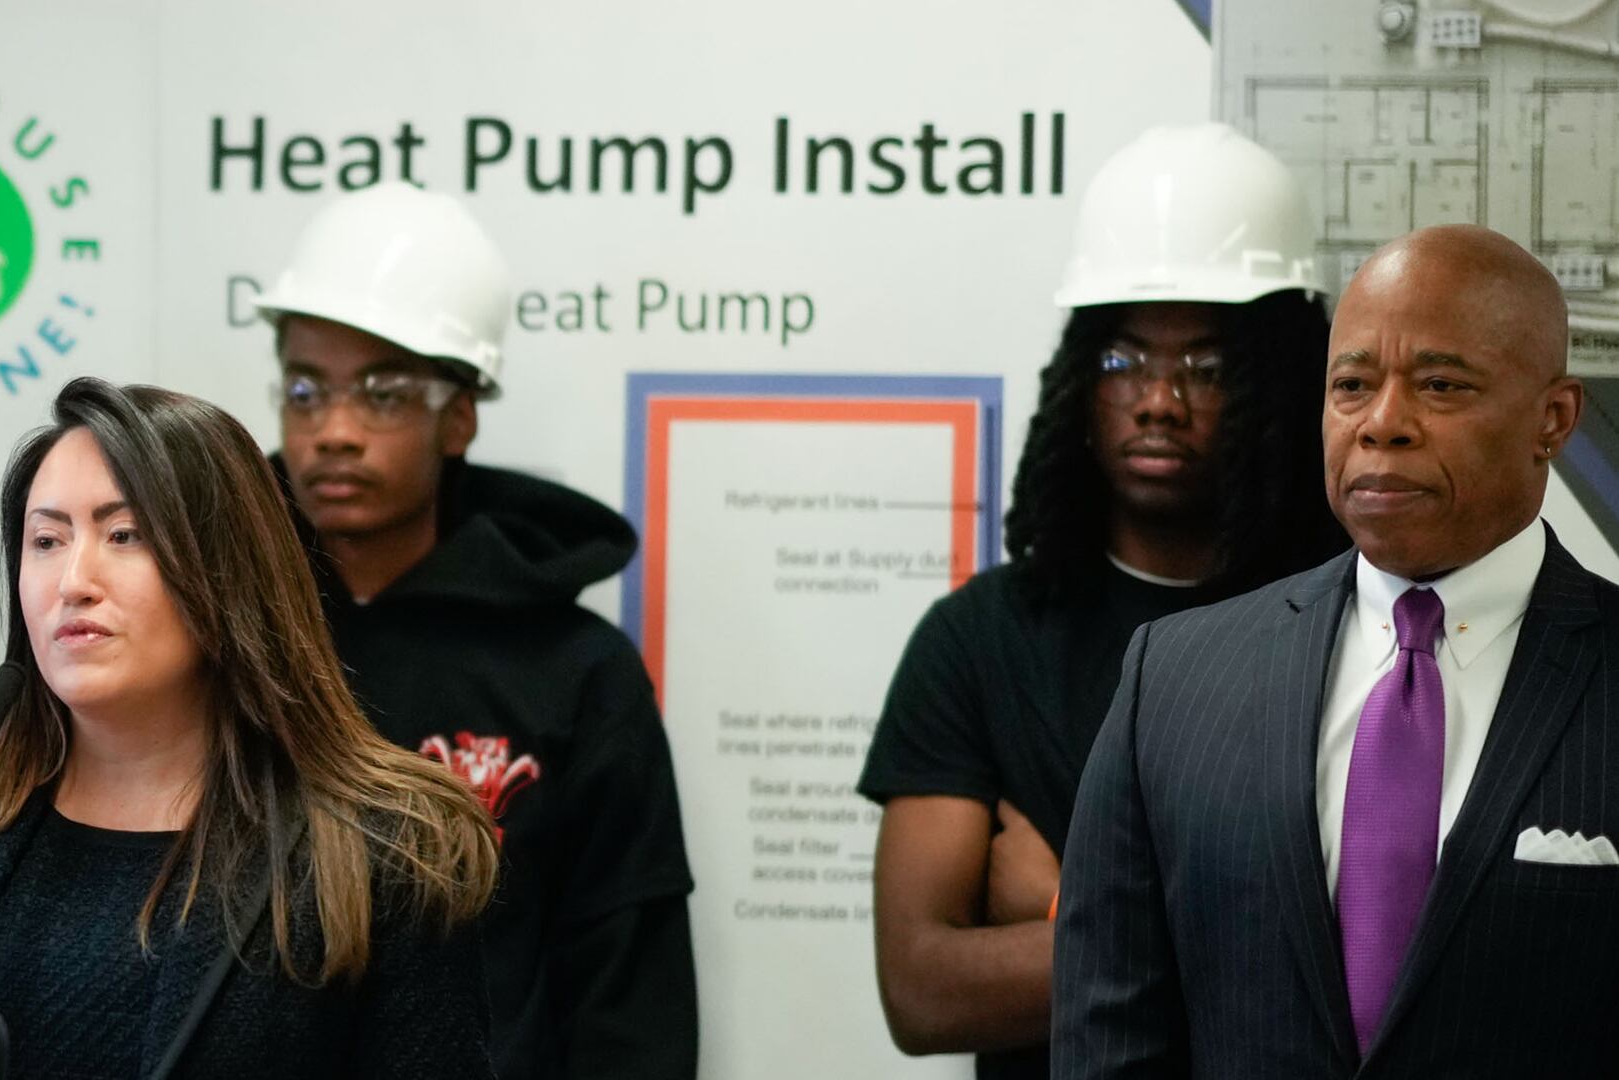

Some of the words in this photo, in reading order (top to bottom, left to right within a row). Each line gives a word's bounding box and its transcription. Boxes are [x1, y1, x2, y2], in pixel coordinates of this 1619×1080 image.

[208, 114, 427, 193] Heat
[463, 116, 736, 215] Pump
[773, 111, 1068, 197] Install
[516, 278, 614, 333] eat
[636, 277, 818, 346] Pump
[723, 488, 828, 514] Refrigerant
[775, 546, 820, 568] Seal
[717, 709, 761, 731] Seal
